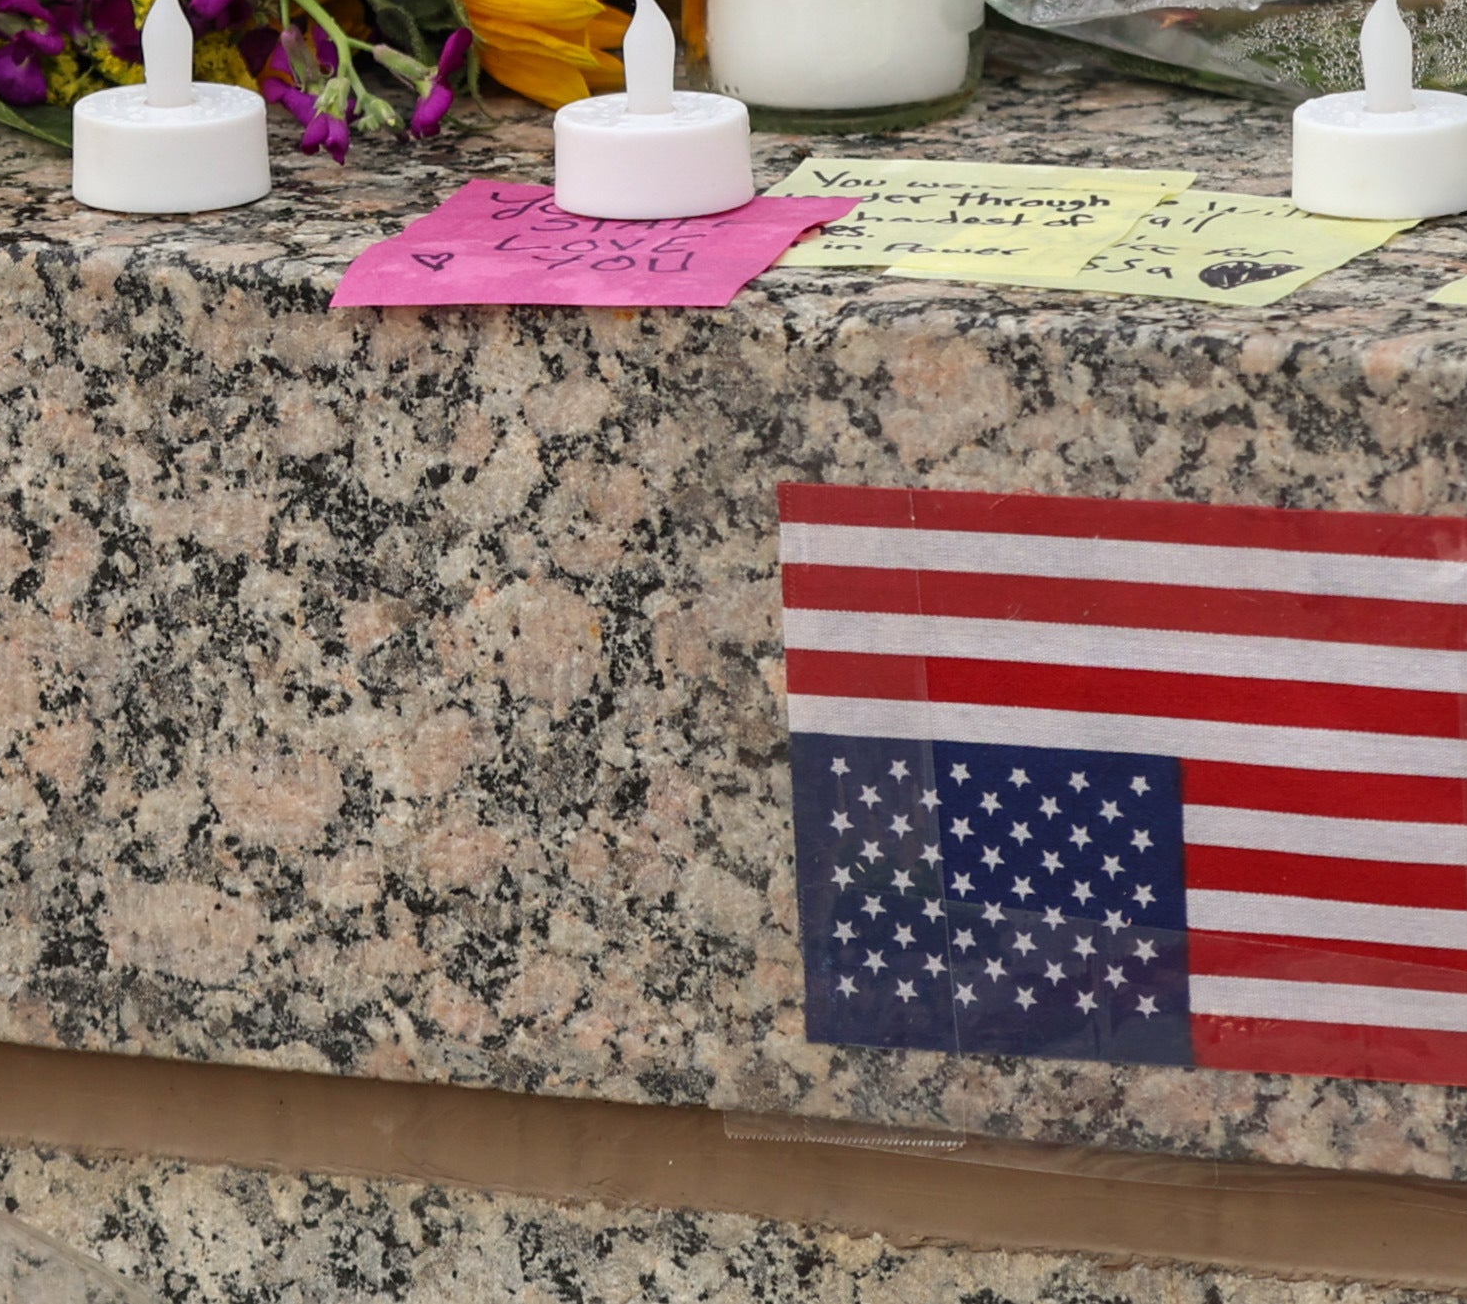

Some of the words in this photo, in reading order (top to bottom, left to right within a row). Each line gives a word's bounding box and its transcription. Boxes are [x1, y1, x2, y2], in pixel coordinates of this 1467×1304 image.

[813, 169, 887, 189] You
[950, 192, 1112, 213] through
[1042, 214, 1095, 228] of
[494, 233, 709, 253] LOVE
[532, 250, 696, 273] YOU
